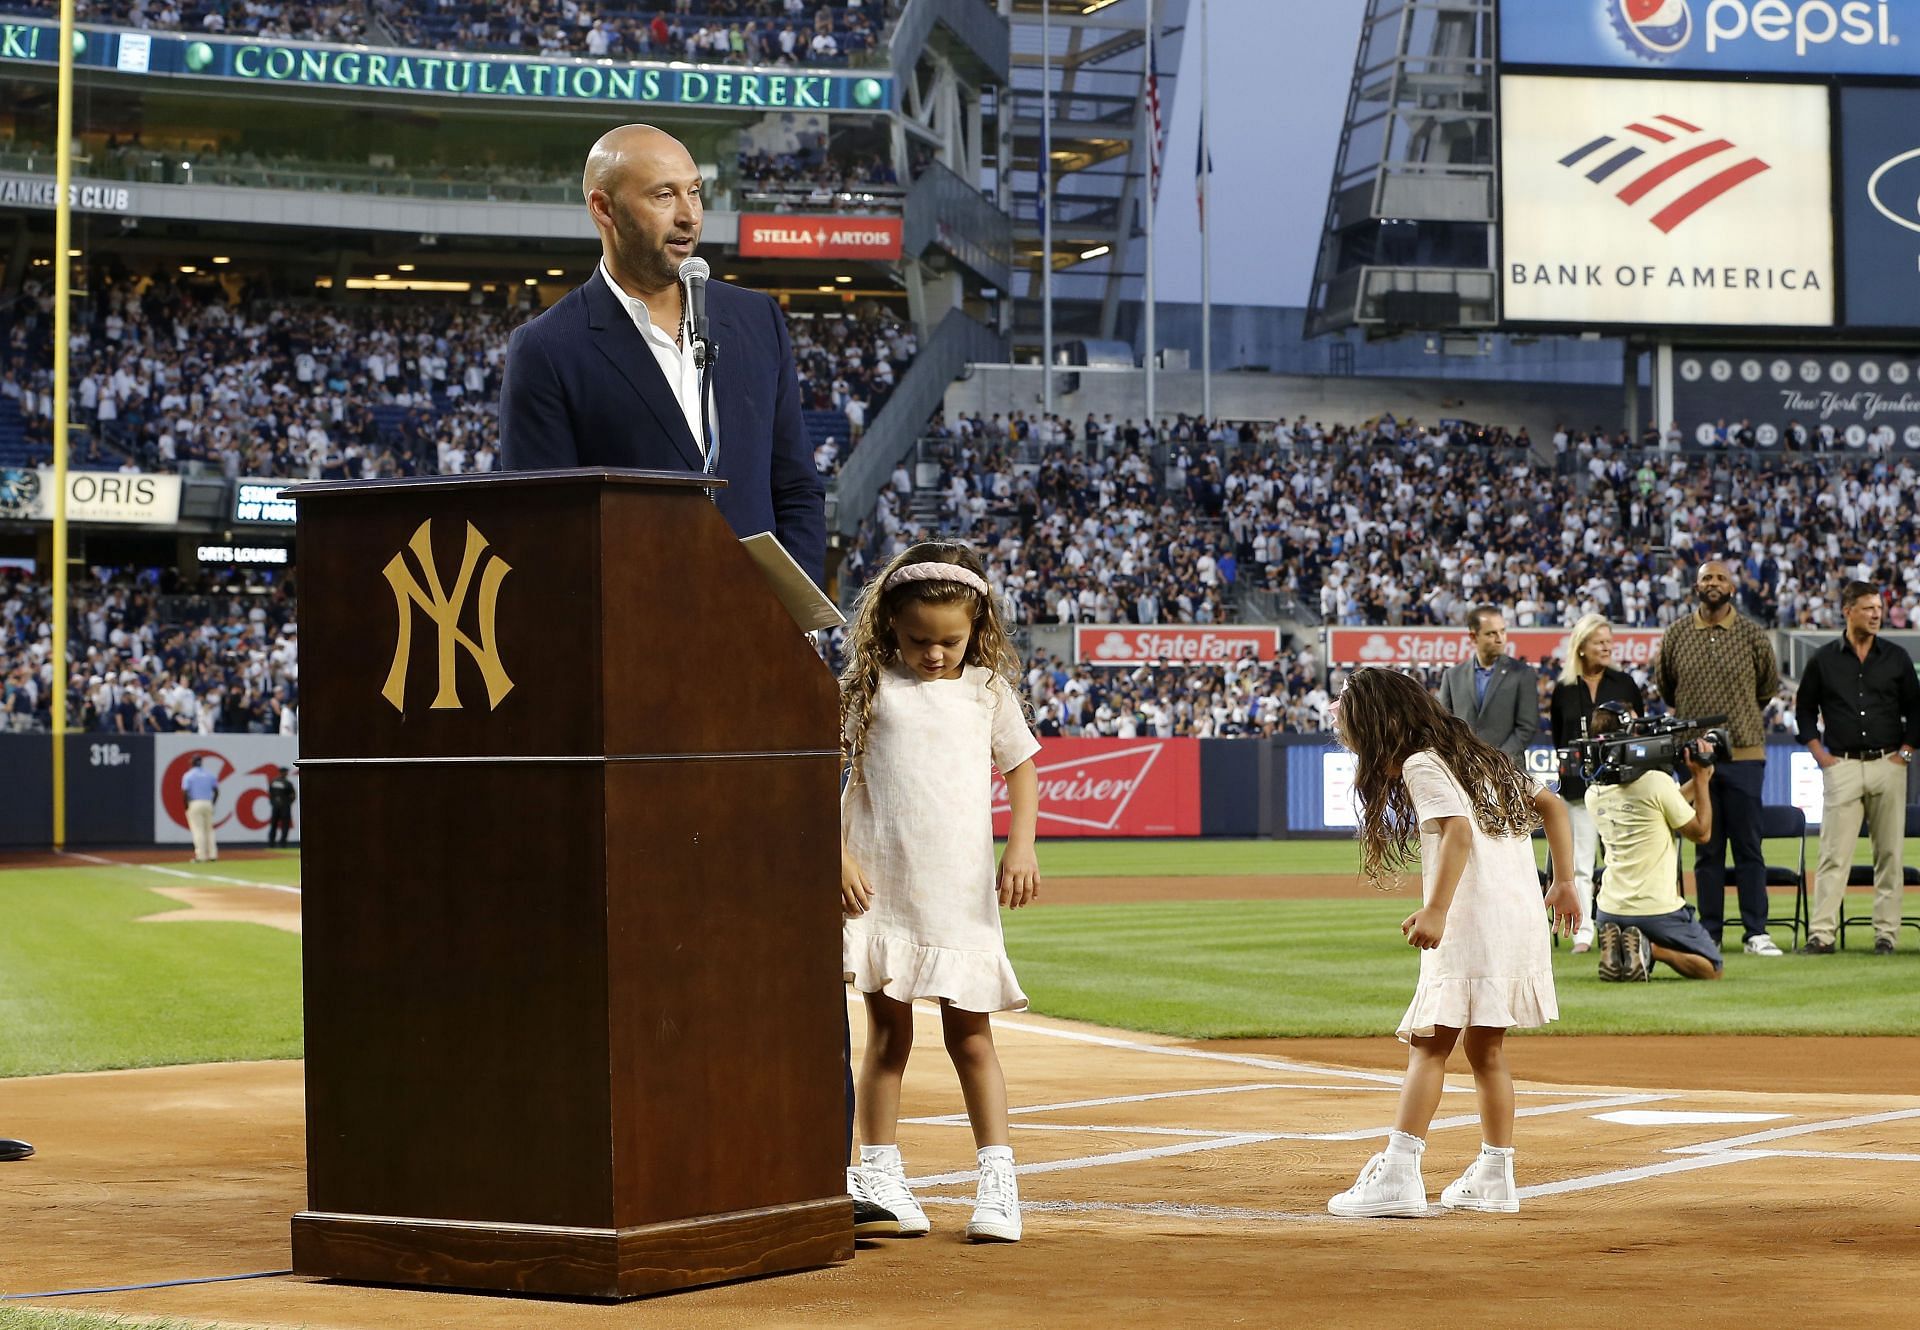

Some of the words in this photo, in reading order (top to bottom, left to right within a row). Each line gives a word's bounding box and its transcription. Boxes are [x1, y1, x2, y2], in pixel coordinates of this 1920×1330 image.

[1706, 0, 1889, 56] pepsi
[234, 45, 661, 100] CONGRATULATIONS
[681, 72, 831, 108] DEREK!
[81, 185, 129, 211] CLUB
[753, 229, 812, 244] STELLA
[830, 231, 891, 245] ARTOIS
[1511, 263, 1602, 286] BANK
[1615, 265, 1656, 287] OF
[1667, 266, 1821, 291] AMERICA
[1819, 391, 1862, 419] York
[72, 476, 155, 505] ORIS
[233, 547, 287, 563] LOUNGE
[381, 517, 515, 713] NY
